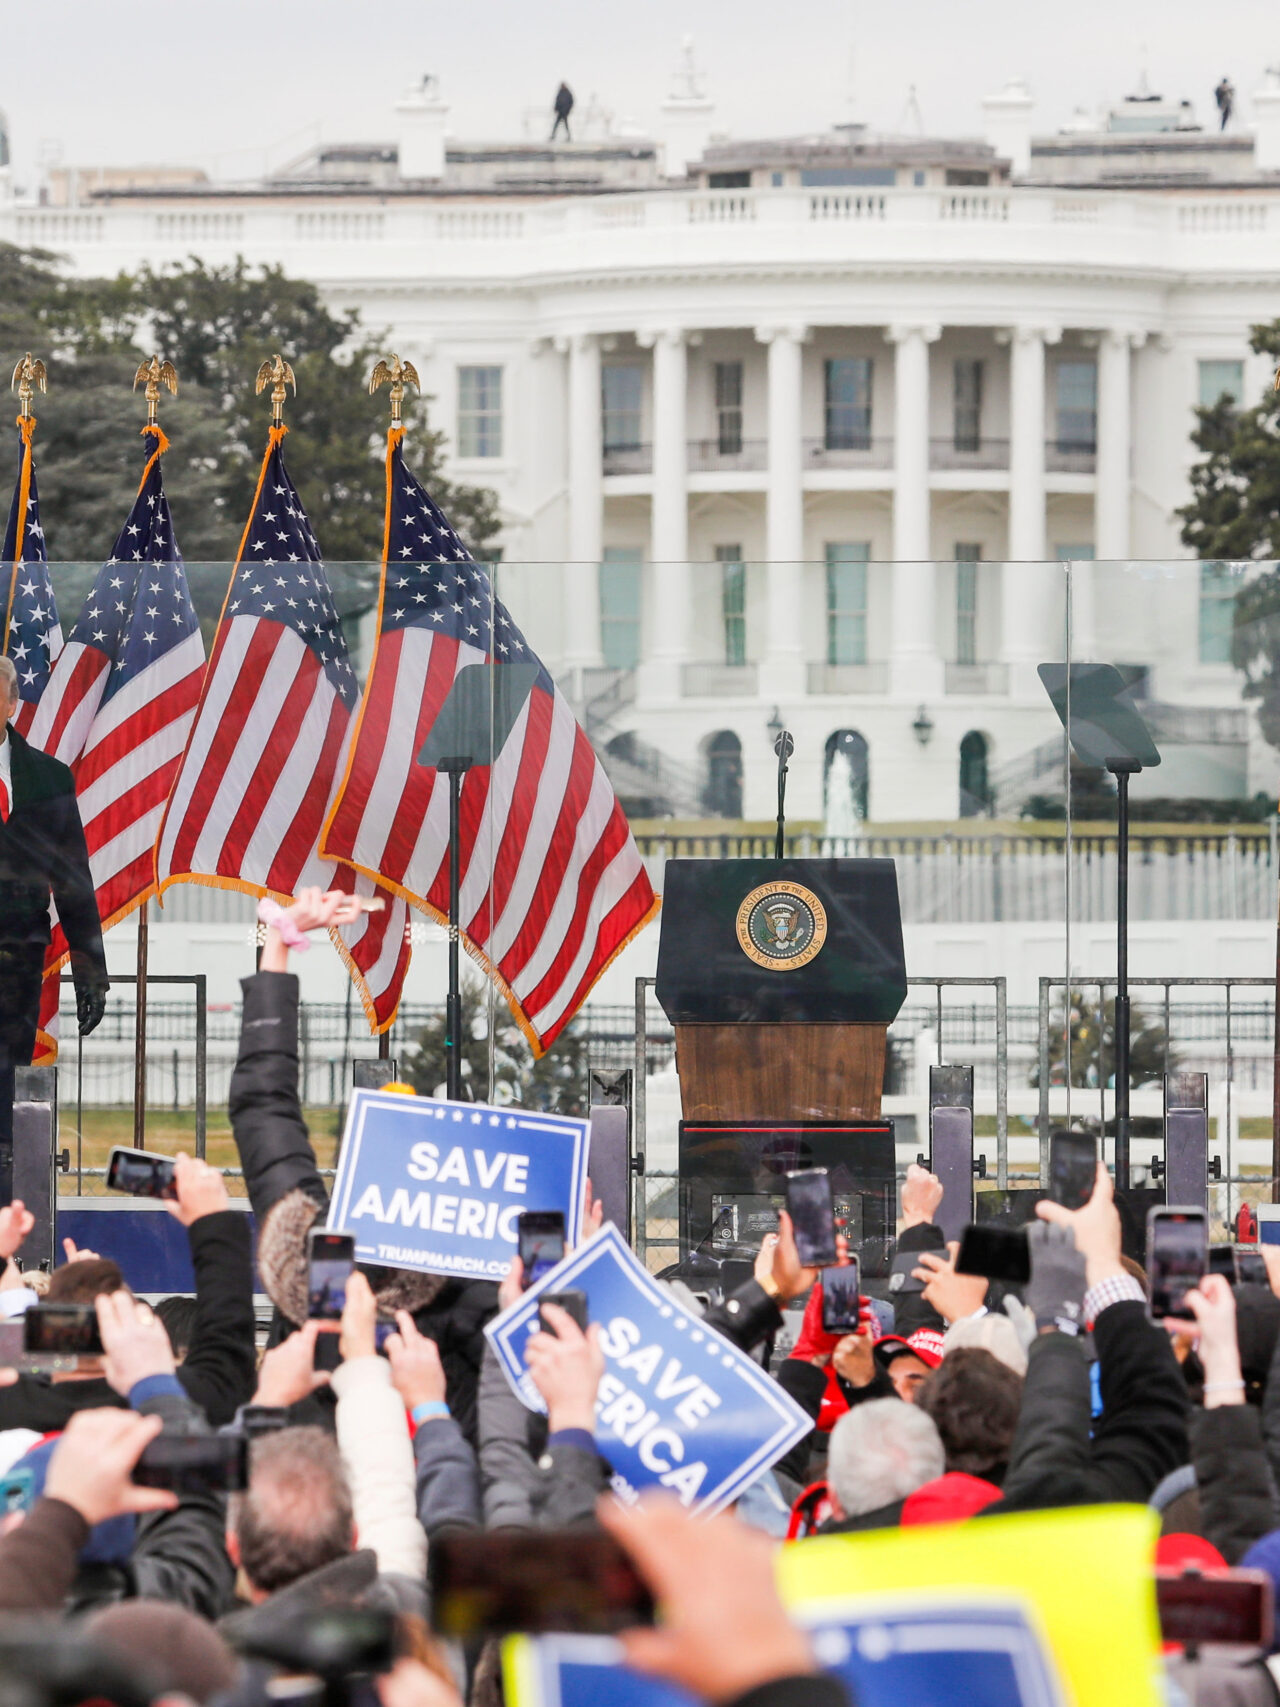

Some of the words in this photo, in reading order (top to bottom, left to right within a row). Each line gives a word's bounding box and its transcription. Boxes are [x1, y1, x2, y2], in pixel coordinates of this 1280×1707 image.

[739, 884, 780, 925] PRESIDENT
[804, 894, 825, 931] UNITED
[751, 947, 775, 967] SEAL
[790, 938, 821, 967] STATES
[407, 1141, 530, 1195] SAVE
[350, 1184, 528, 1244] AMERIC
[376, 1243, 513, 1276] TRUMPMARCH.CO
[597, 1316, 722, 1430] SAVE
[596, 1373, 709, 1508] ERICA
